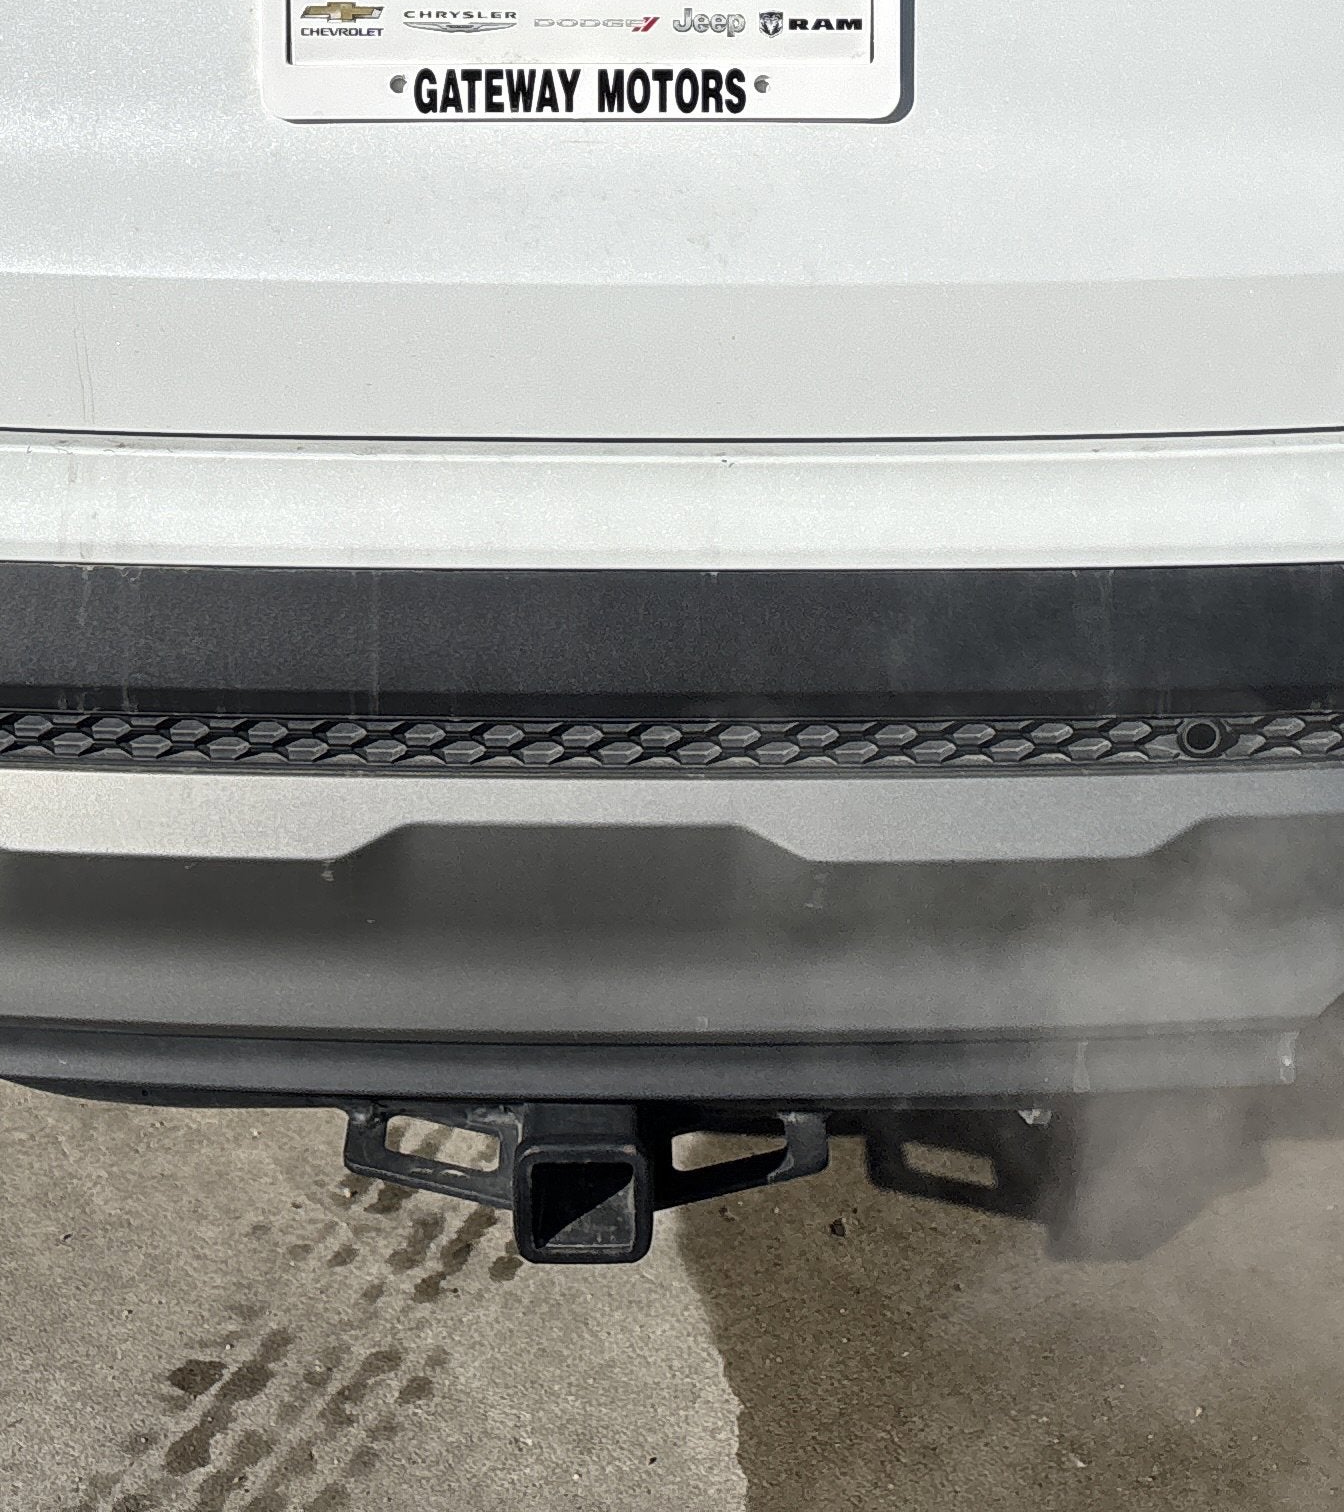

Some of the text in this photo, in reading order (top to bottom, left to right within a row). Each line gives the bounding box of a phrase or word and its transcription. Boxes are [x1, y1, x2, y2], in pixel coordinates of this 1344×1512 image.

[300, 7, 863, 37] CHEVROLET CHRYSLER DODGE Jeep RAM
[413, 67, 747, 114] GATEWAY MOTORS
